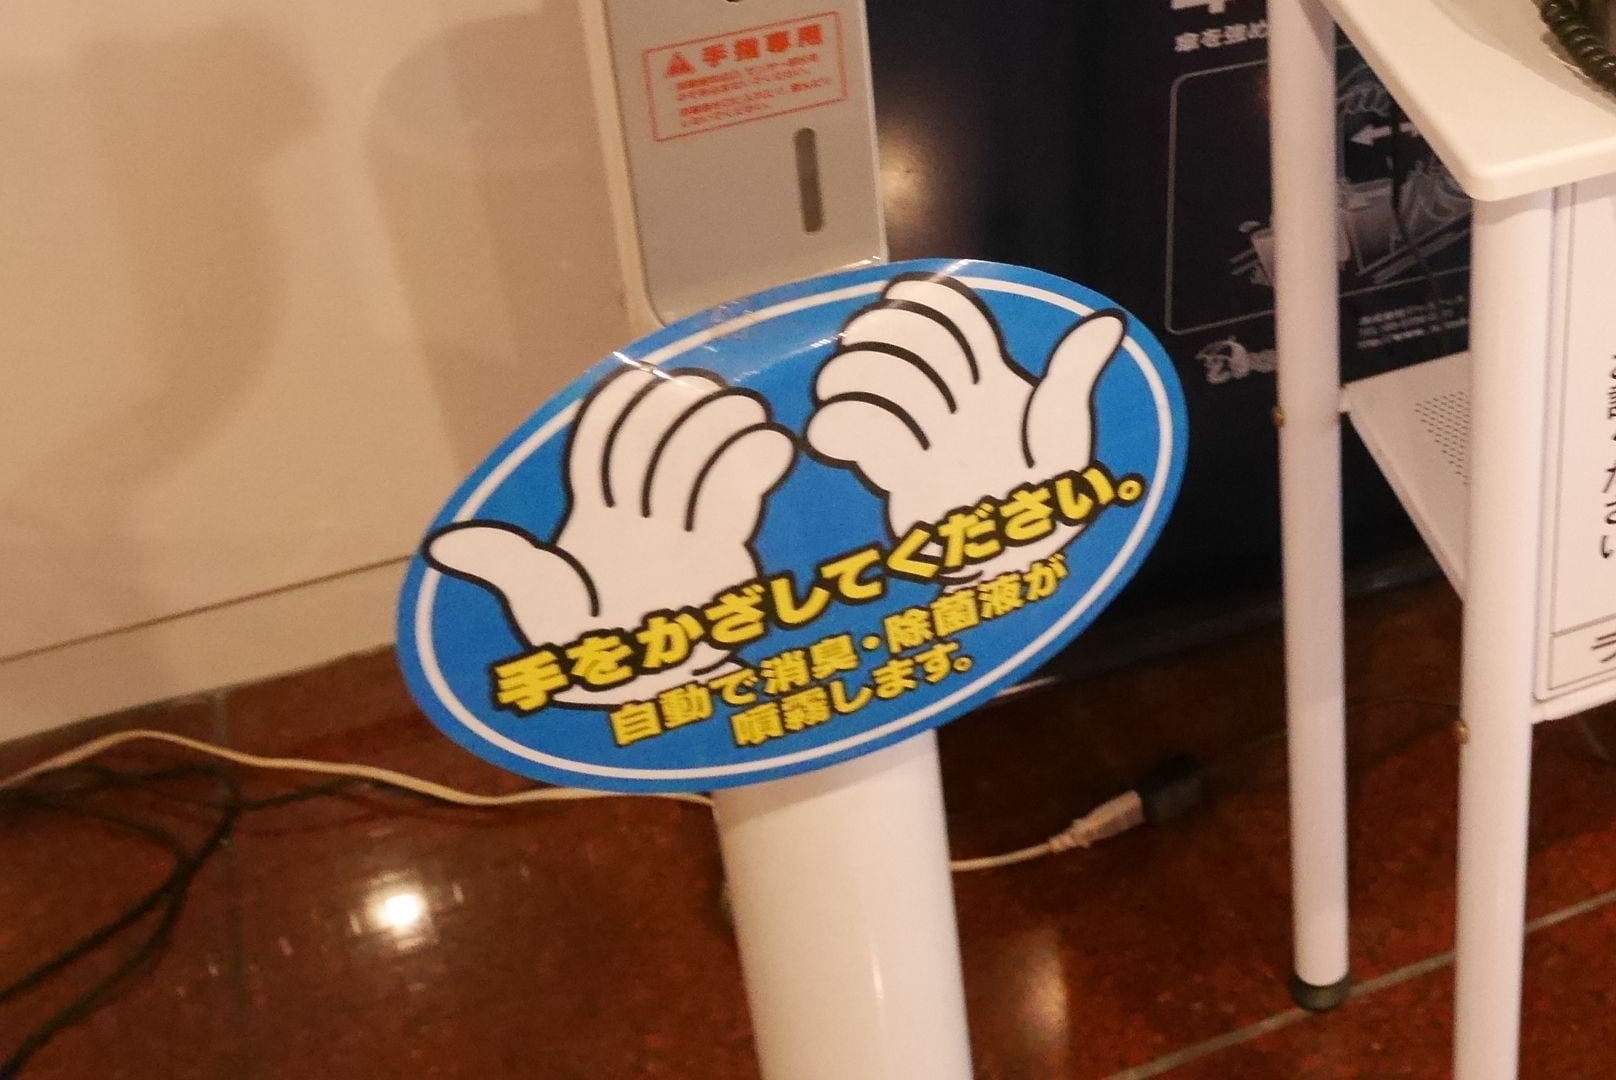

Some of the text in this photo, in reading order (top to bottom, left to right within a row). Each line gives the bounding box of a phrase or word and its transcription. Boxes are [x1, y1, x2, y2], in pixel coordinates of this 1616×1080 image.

[494, 463, 1144, 714] 手をかざしてください。
[610, 556, 1069, 746] 自動で消臭・除菌液が
[730, 643, 973, 748] 噴霧します。
